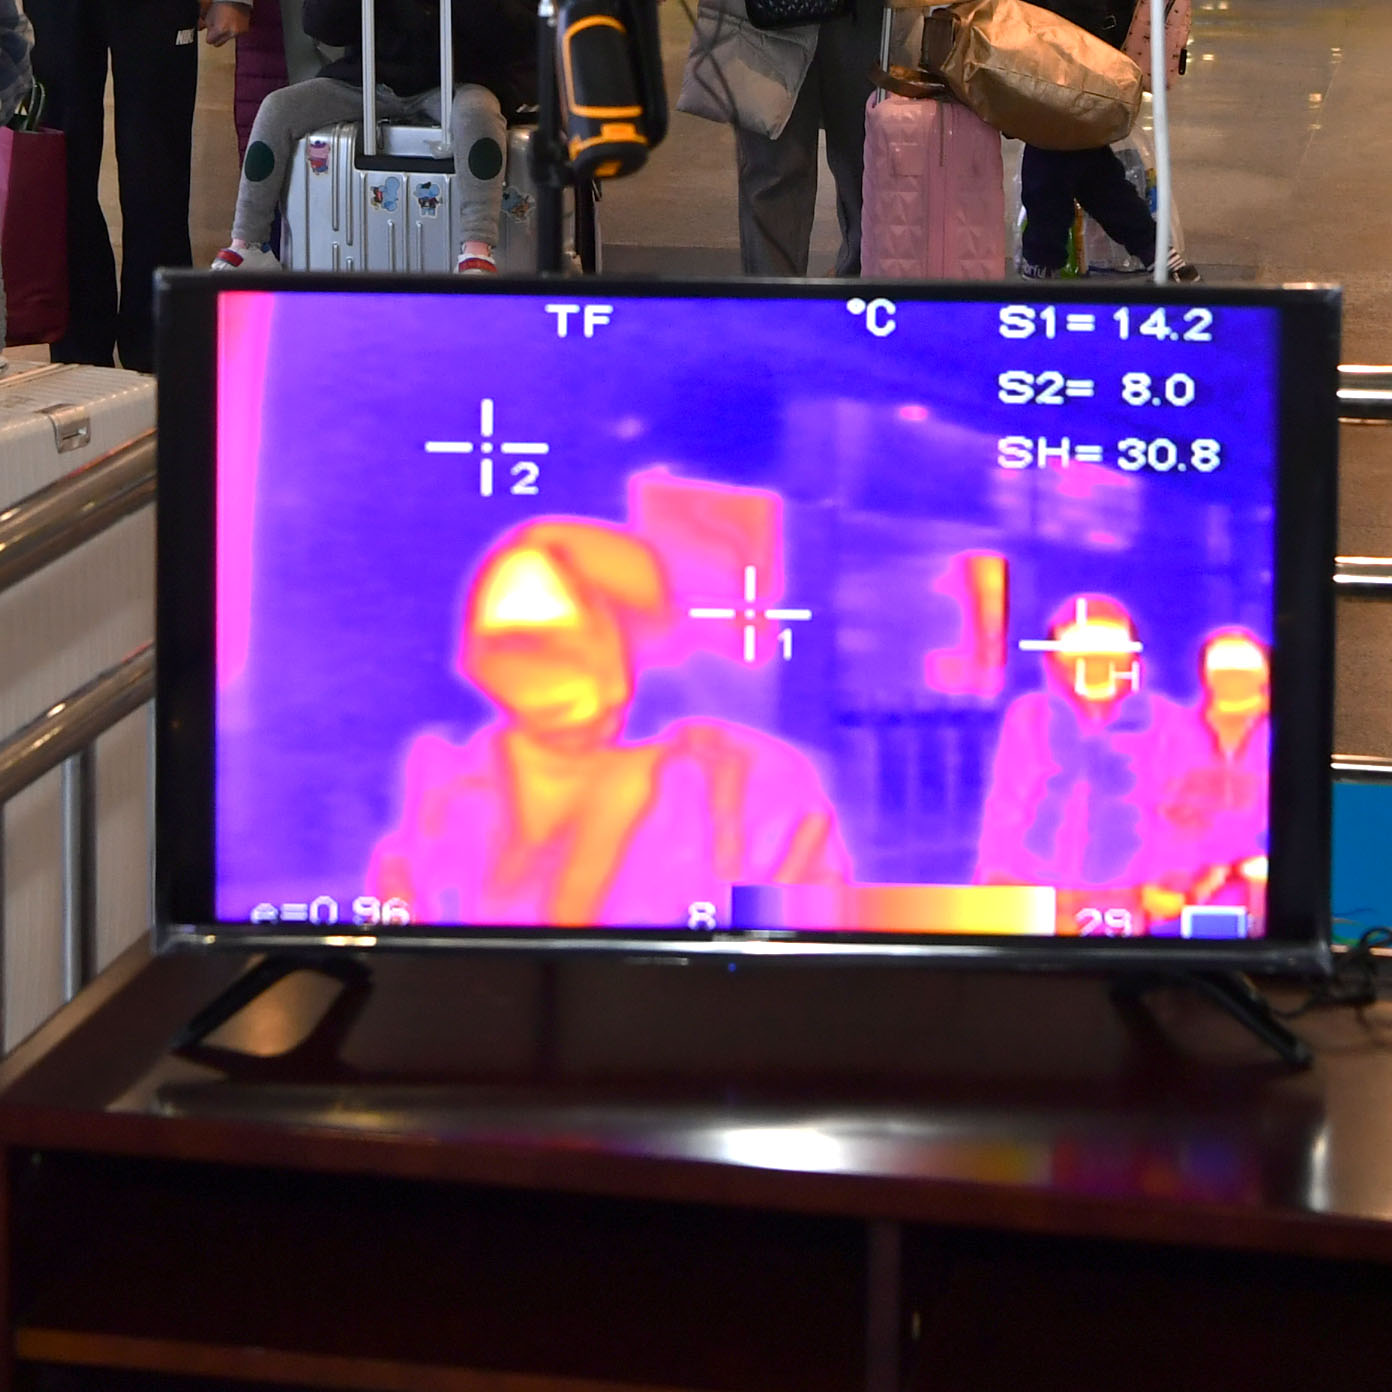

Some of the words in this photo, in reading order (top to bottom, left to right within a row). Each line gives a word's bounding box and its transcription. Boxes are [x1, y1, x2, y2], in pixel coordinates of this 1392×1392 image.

[544, 304, 614, 338] TF
[846, 298, 897, 337] °C
[999, 304, 1096, 340] S1=
[1113, 306, 1213, 342] 14.2
[998, 370, 1095, 405] S2=
[1121, 372, 1196, 407] 8.0
[997, 435, 1103, 470] SH=
[1117, 437, 1221, 473] 30.8
[510, 461, 540, 496] 2
[777, 627, 792, 661] 1
